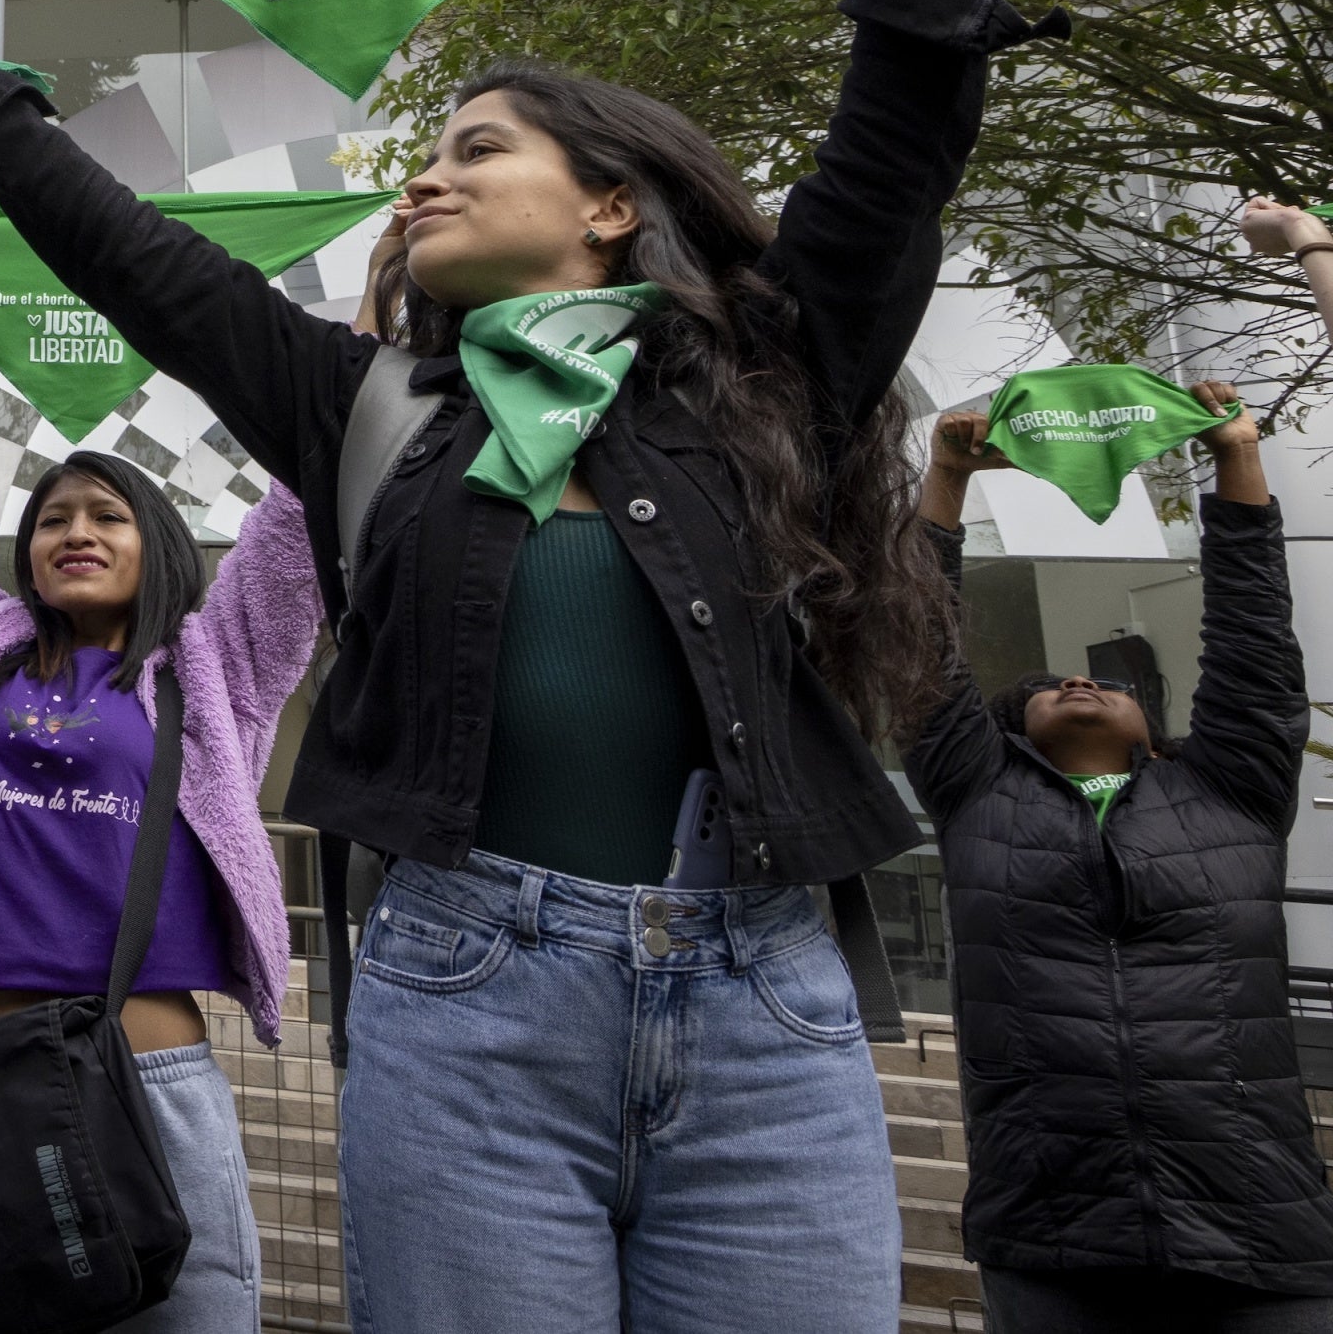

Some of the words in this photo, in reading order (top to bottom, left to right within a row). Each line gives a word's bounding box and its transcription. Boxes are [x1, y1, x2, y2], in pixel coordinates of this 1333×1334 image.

[21, 292, 31, 305] el
[35, 293, 75, 306] aborto
[538, 293, 574, 314] PARA
[43, 310, 109, 336] JUSTA
[29, 337, 123, 364] LIBERTAD
[1009, 410, 1078, 435] DERECHO
[1078, 414, 1087, 424] al
[1088, 405, 1156, 428] ABORTO
[48, 787, 66, 810] de
[71, 788, 121, 815] Frente
[36, 1144, 85, 1257] AMERICANINO
